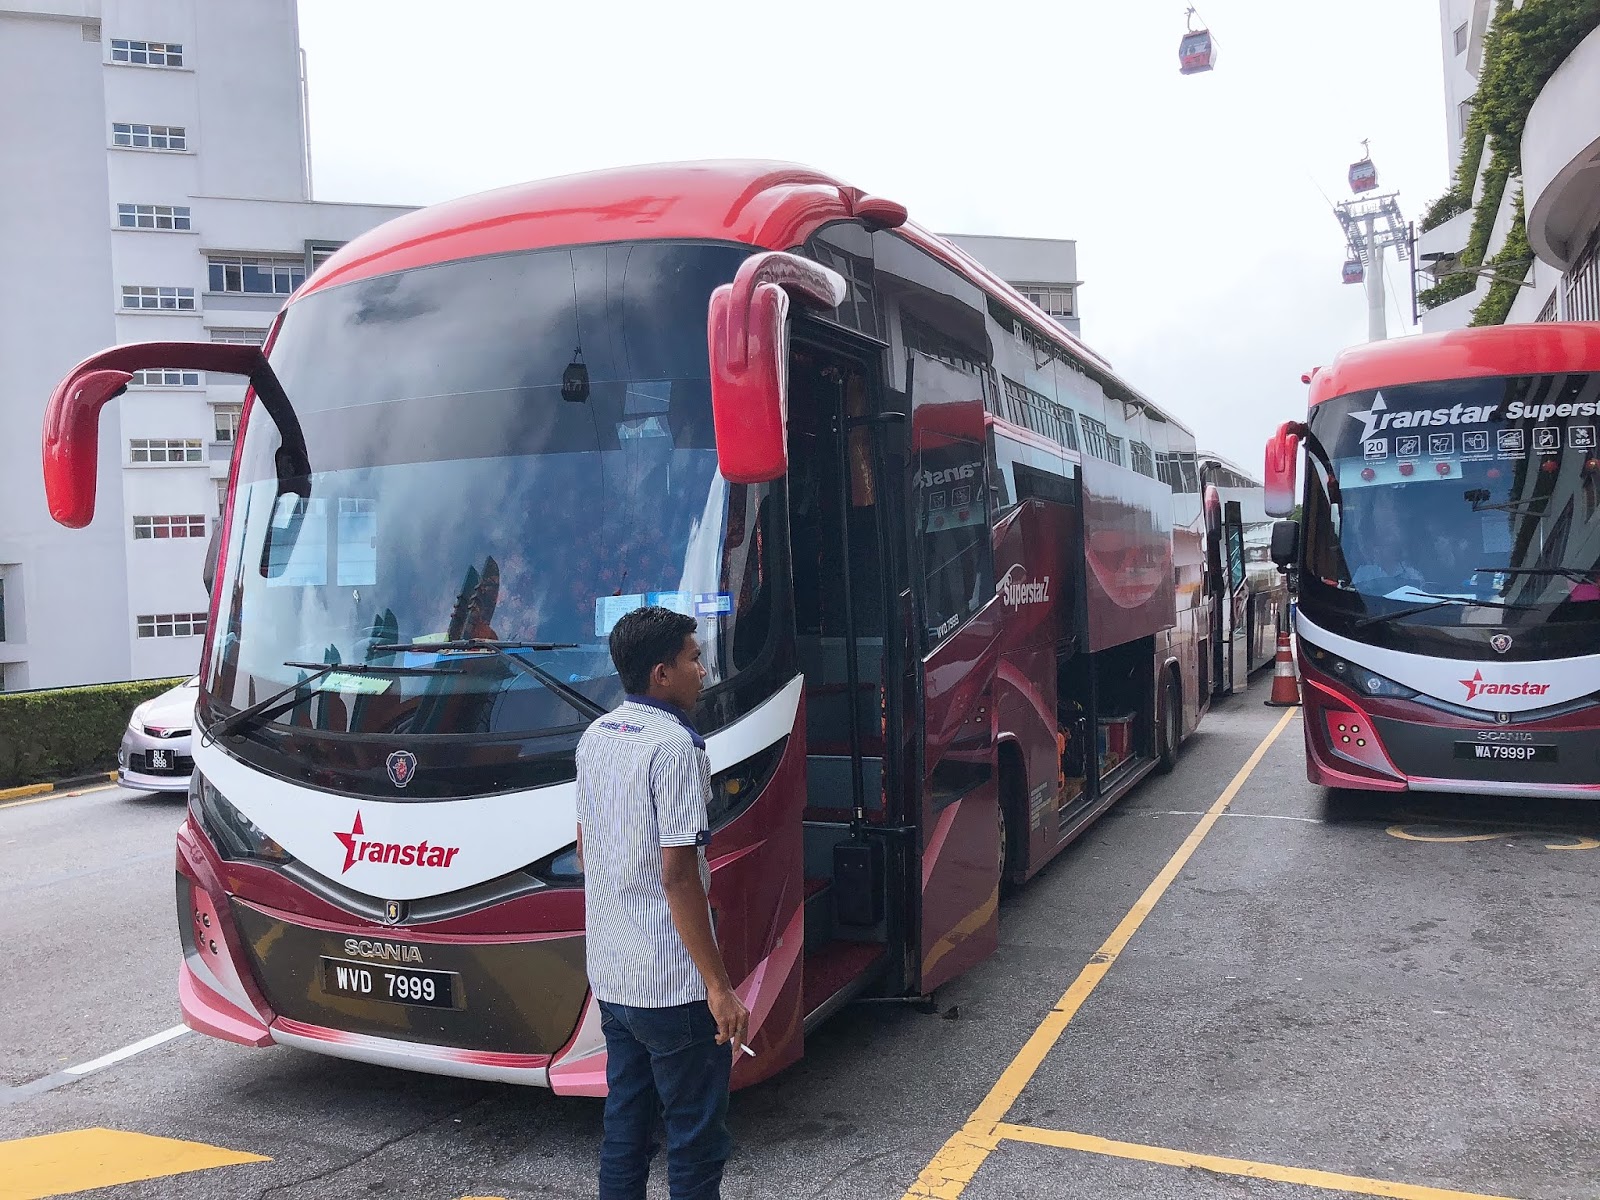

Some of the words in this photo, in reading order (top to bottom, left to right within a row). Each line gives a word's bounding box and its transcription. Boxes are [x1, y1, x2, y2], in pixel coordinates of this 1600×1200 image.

[1347, 390, 1499, 444] Transtar
[1367, 441, 1384, 453] 20
[1458, 668, 1550, 701] Transtar
[1477, 731, 1533, 741] SCANIA
[333, 809, 460, 874] Transtar
[344, 938, 424, 963] SCANIA
[336, 966, 373, 994] WVD
[384, 973, 436, 1001] 7999
